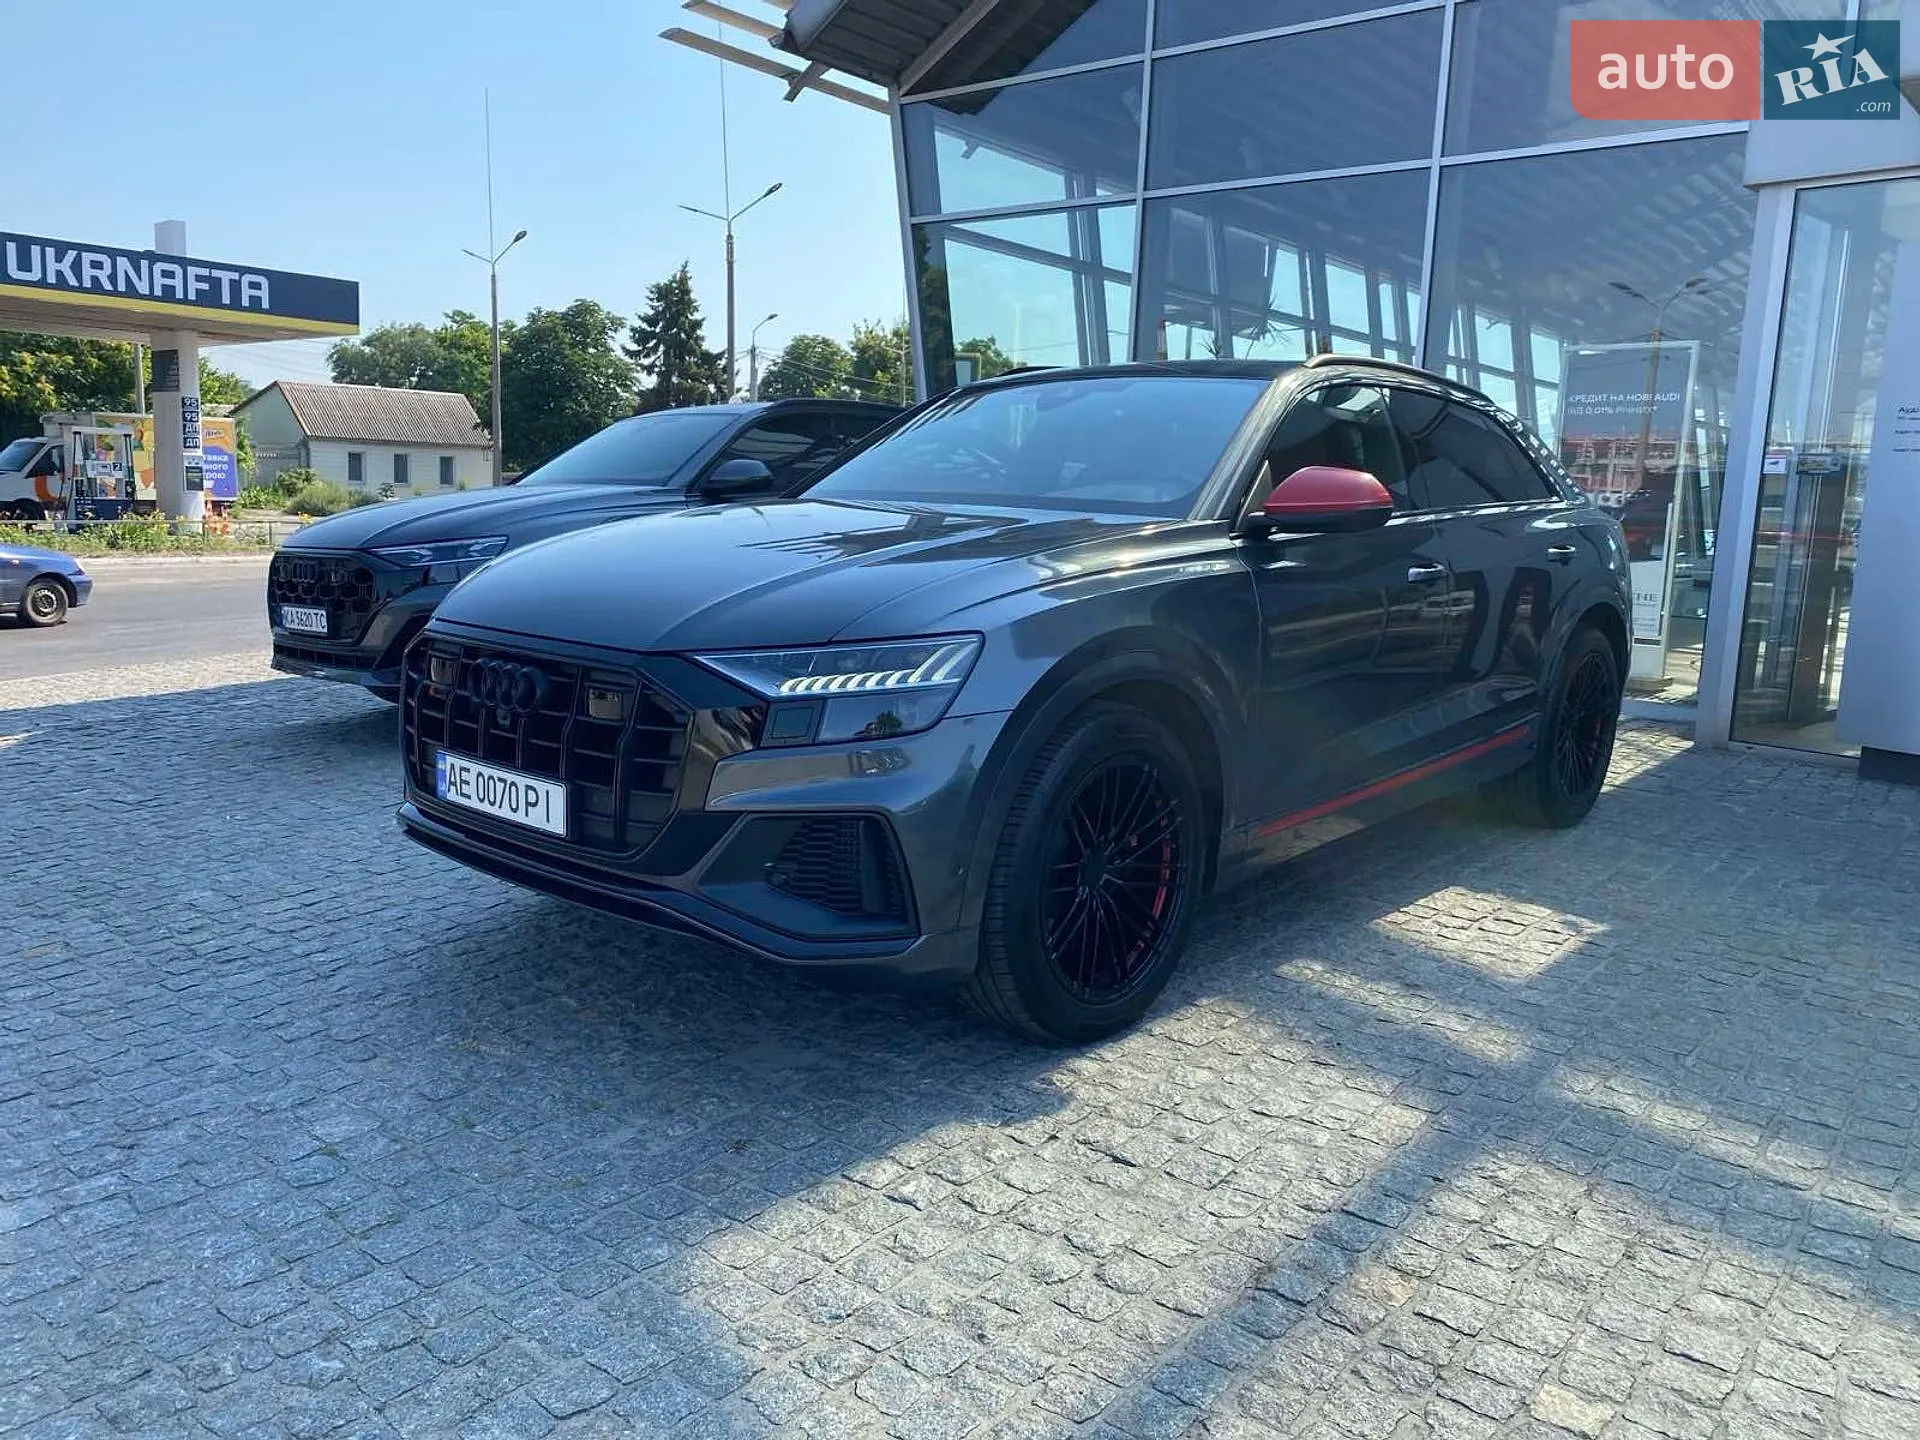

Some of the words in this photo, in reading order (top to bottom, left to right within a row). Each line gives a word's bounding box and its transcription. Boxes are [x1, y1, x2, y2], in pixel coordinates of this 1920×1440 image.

[6, 241, 270, 309] UKRNAFTA
[184, 398, 197, 407] 95
[185, 412, 198, 421] 95
[186, 437, 200, 448] ДП
[448, 763, 472, 800] AE
[476, 771, 520, 813] 0070
[524, 784, 550, 823] PI
